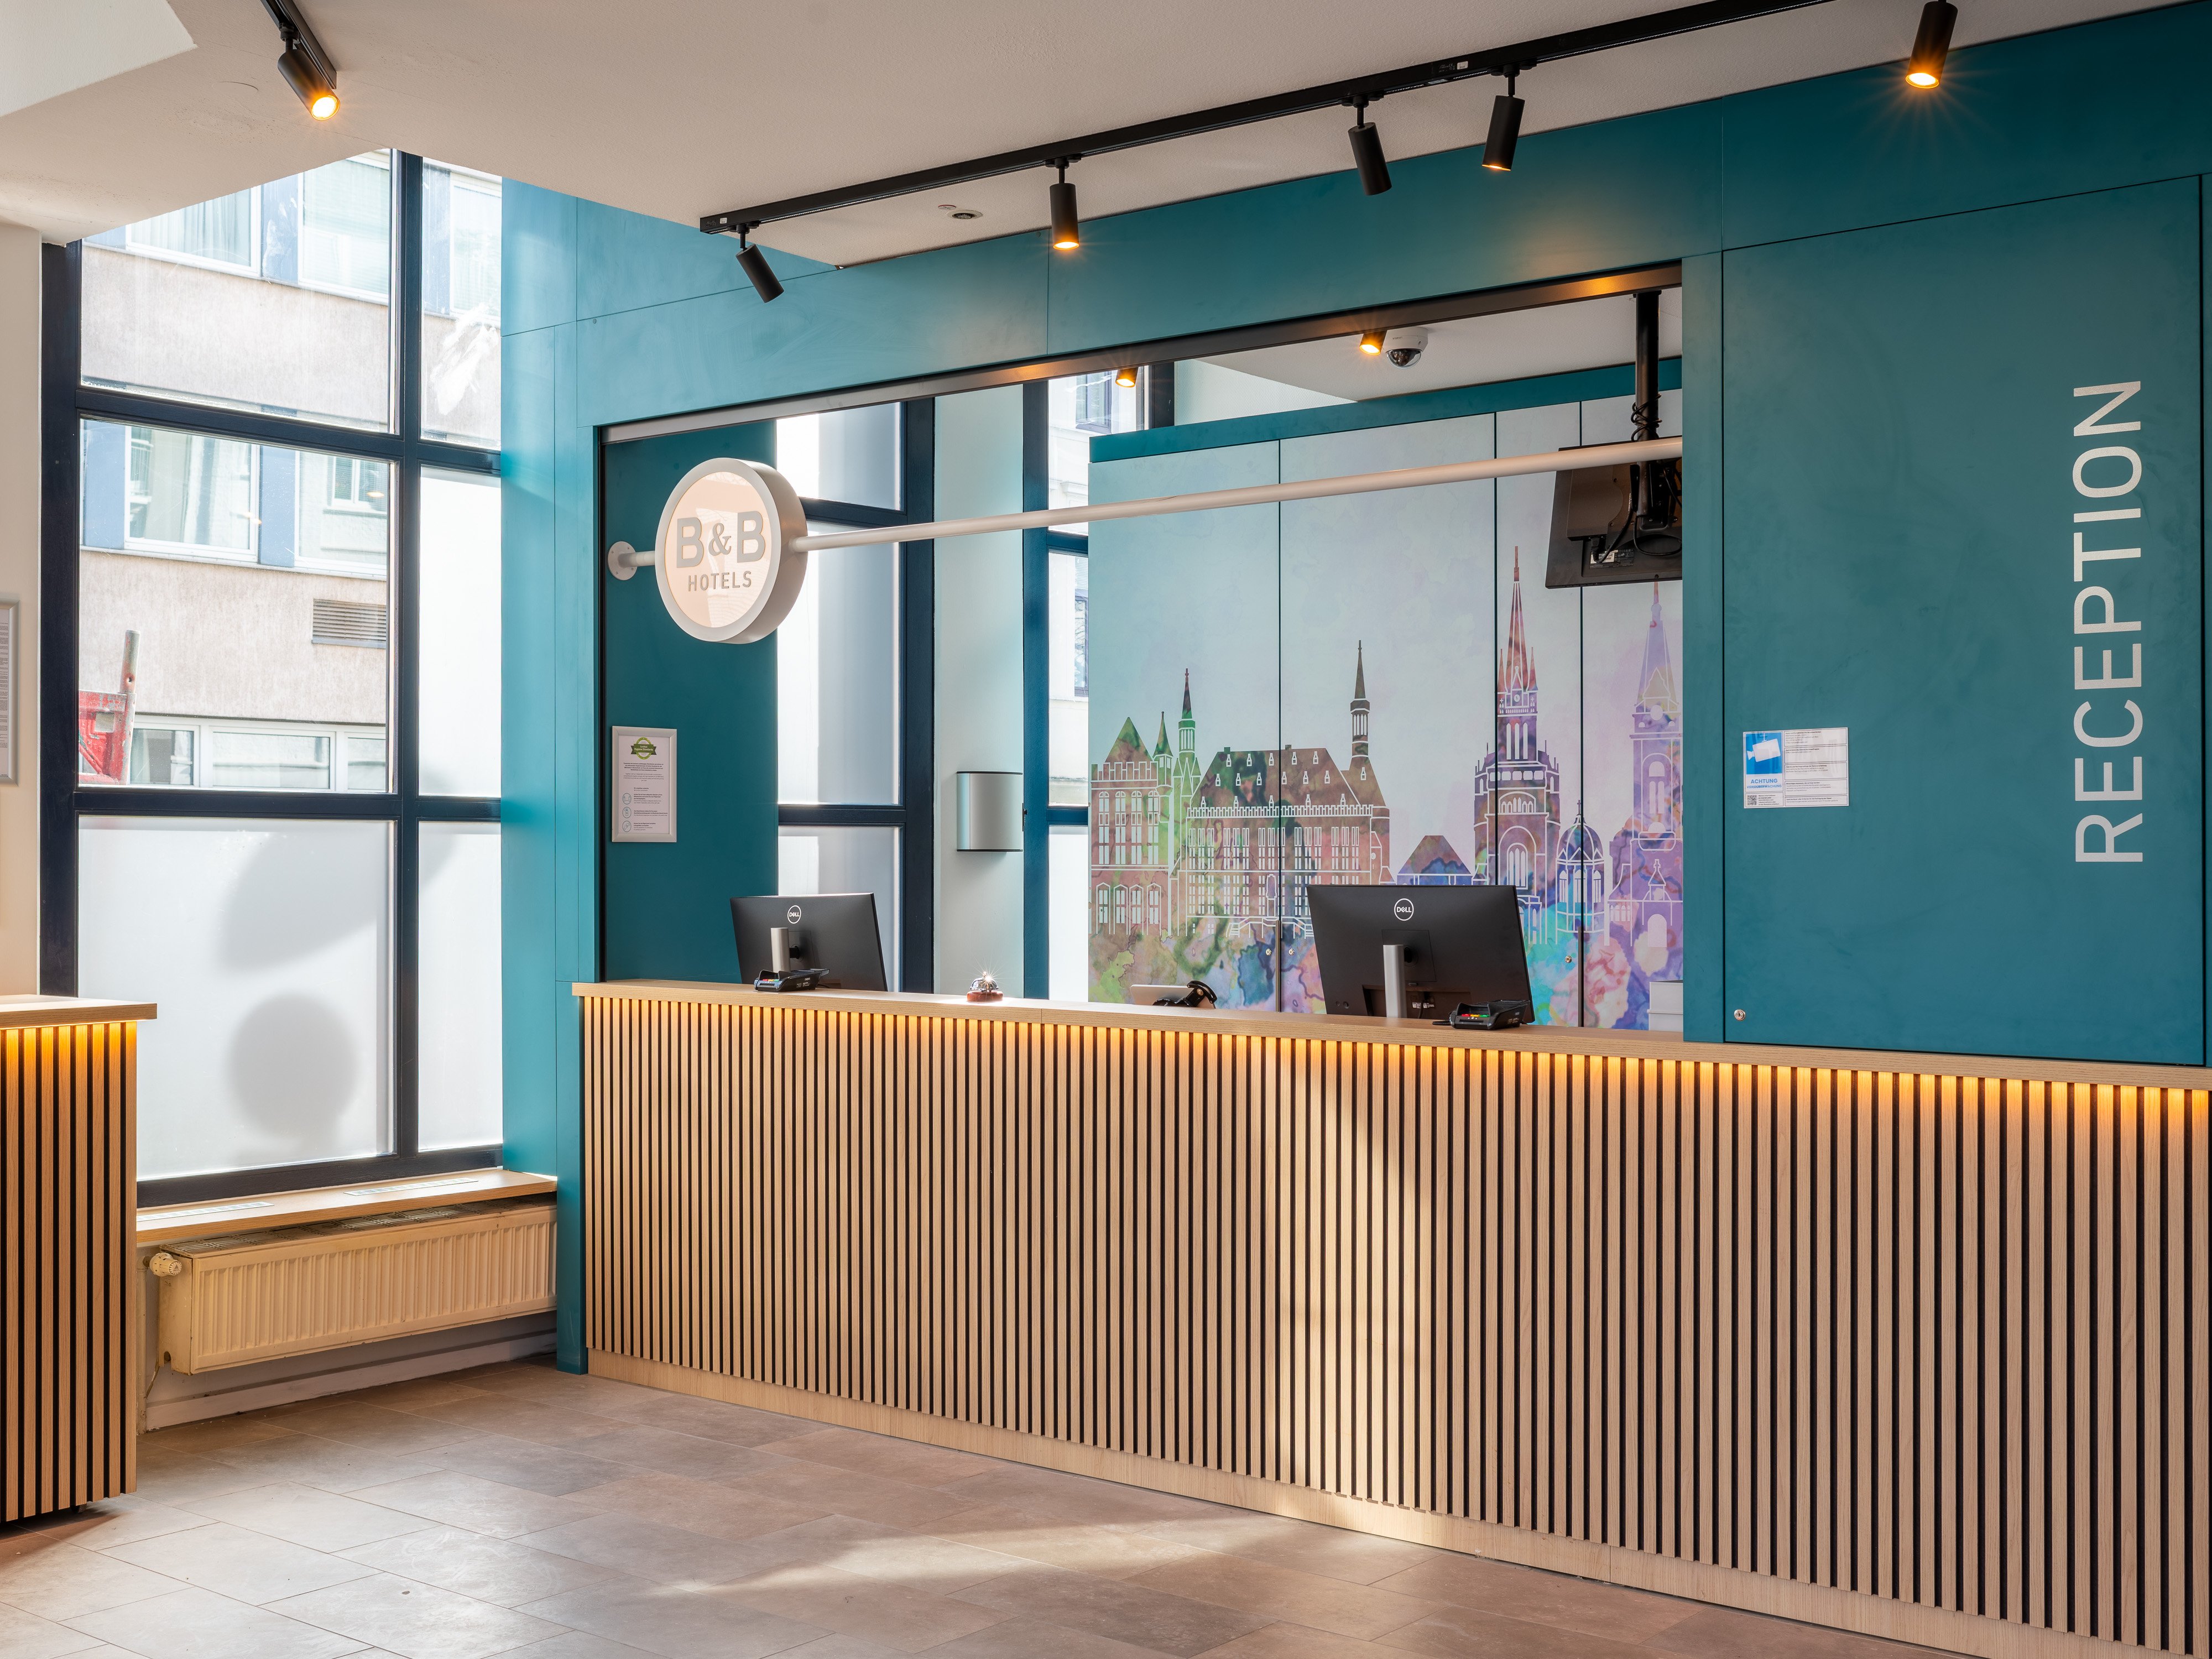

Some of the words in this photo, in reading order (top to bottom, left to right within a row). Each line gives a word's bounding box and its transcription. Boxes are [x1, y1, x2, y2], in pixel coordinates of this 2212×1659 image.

[676, 510, 766, 568] B&B
[688, 570, 752, 592] HOTELS
[2072, 380, 2143, 863] RECEPTION
